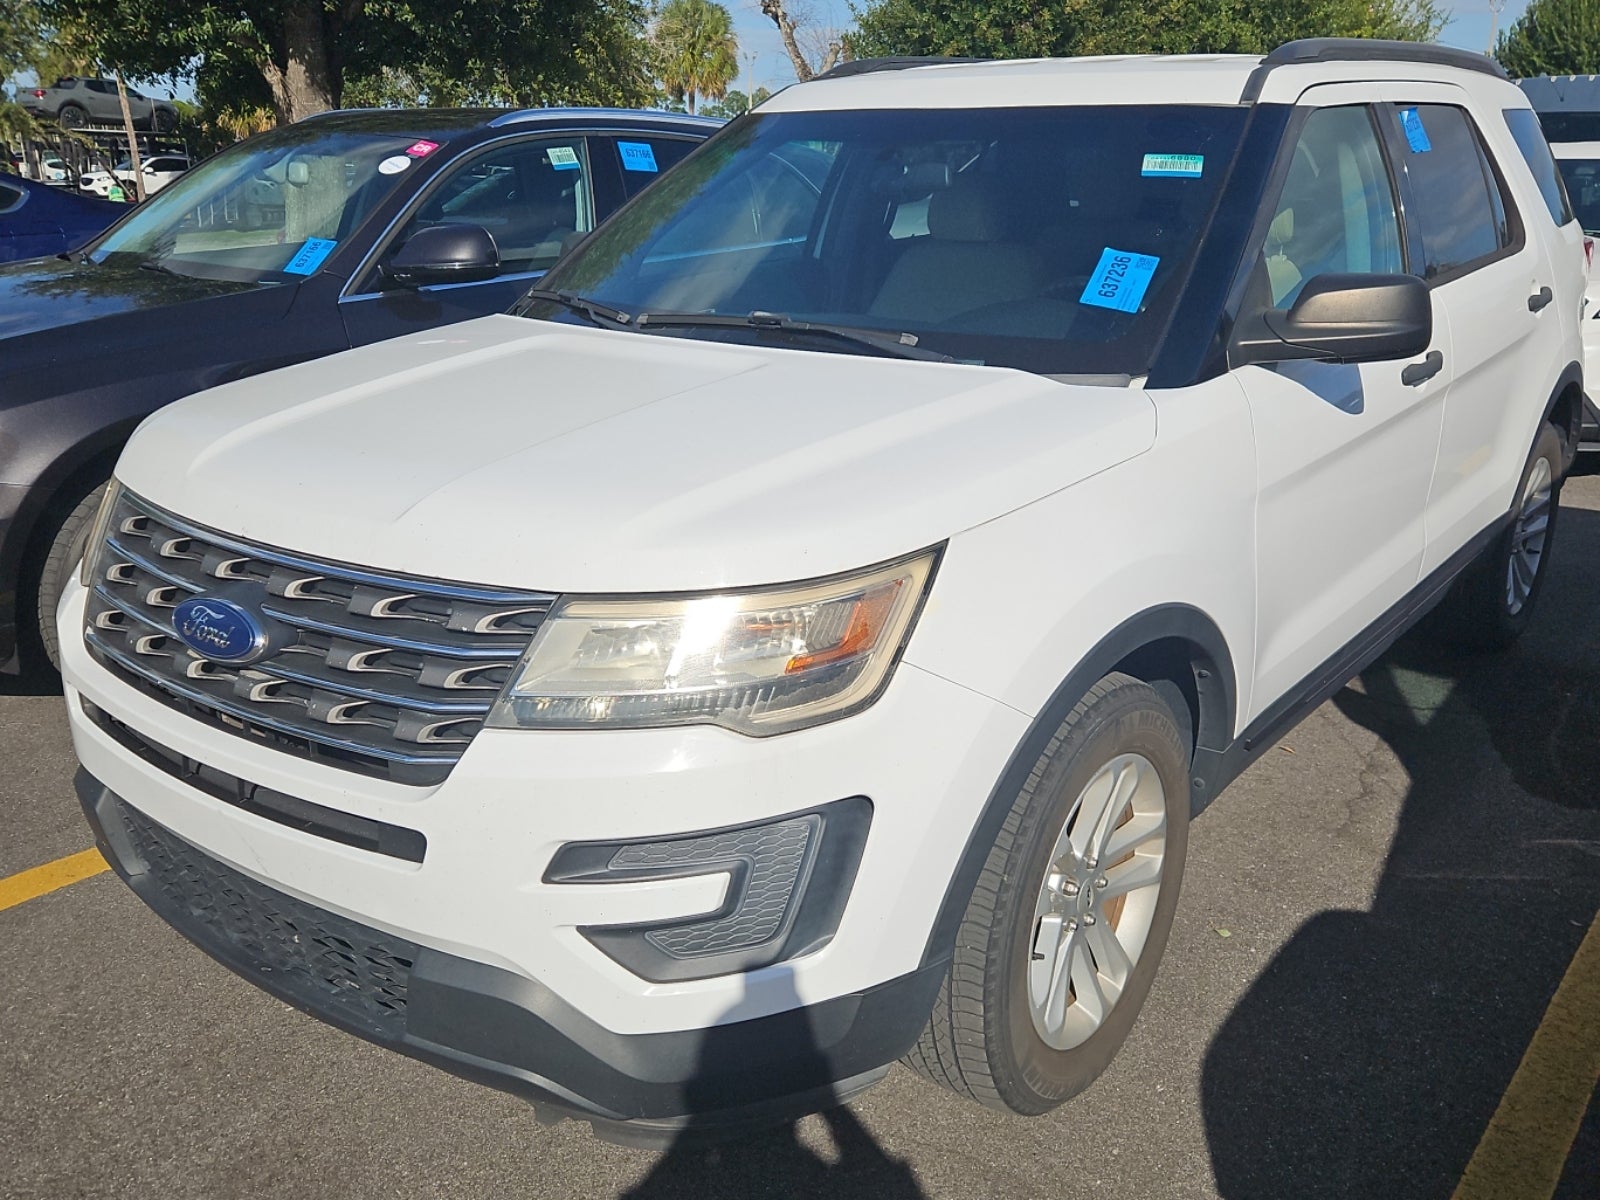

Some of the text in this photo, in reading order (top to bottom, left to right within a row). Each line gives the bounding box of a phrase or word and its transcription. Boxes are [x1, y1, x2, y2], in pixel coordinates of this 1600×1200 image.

[412, 143, 432, 153] CR
[294, 241, 322, 268] 637166
[1097, 255, 1132, 298] 637236
[182, 605, 236, 649] Ford
